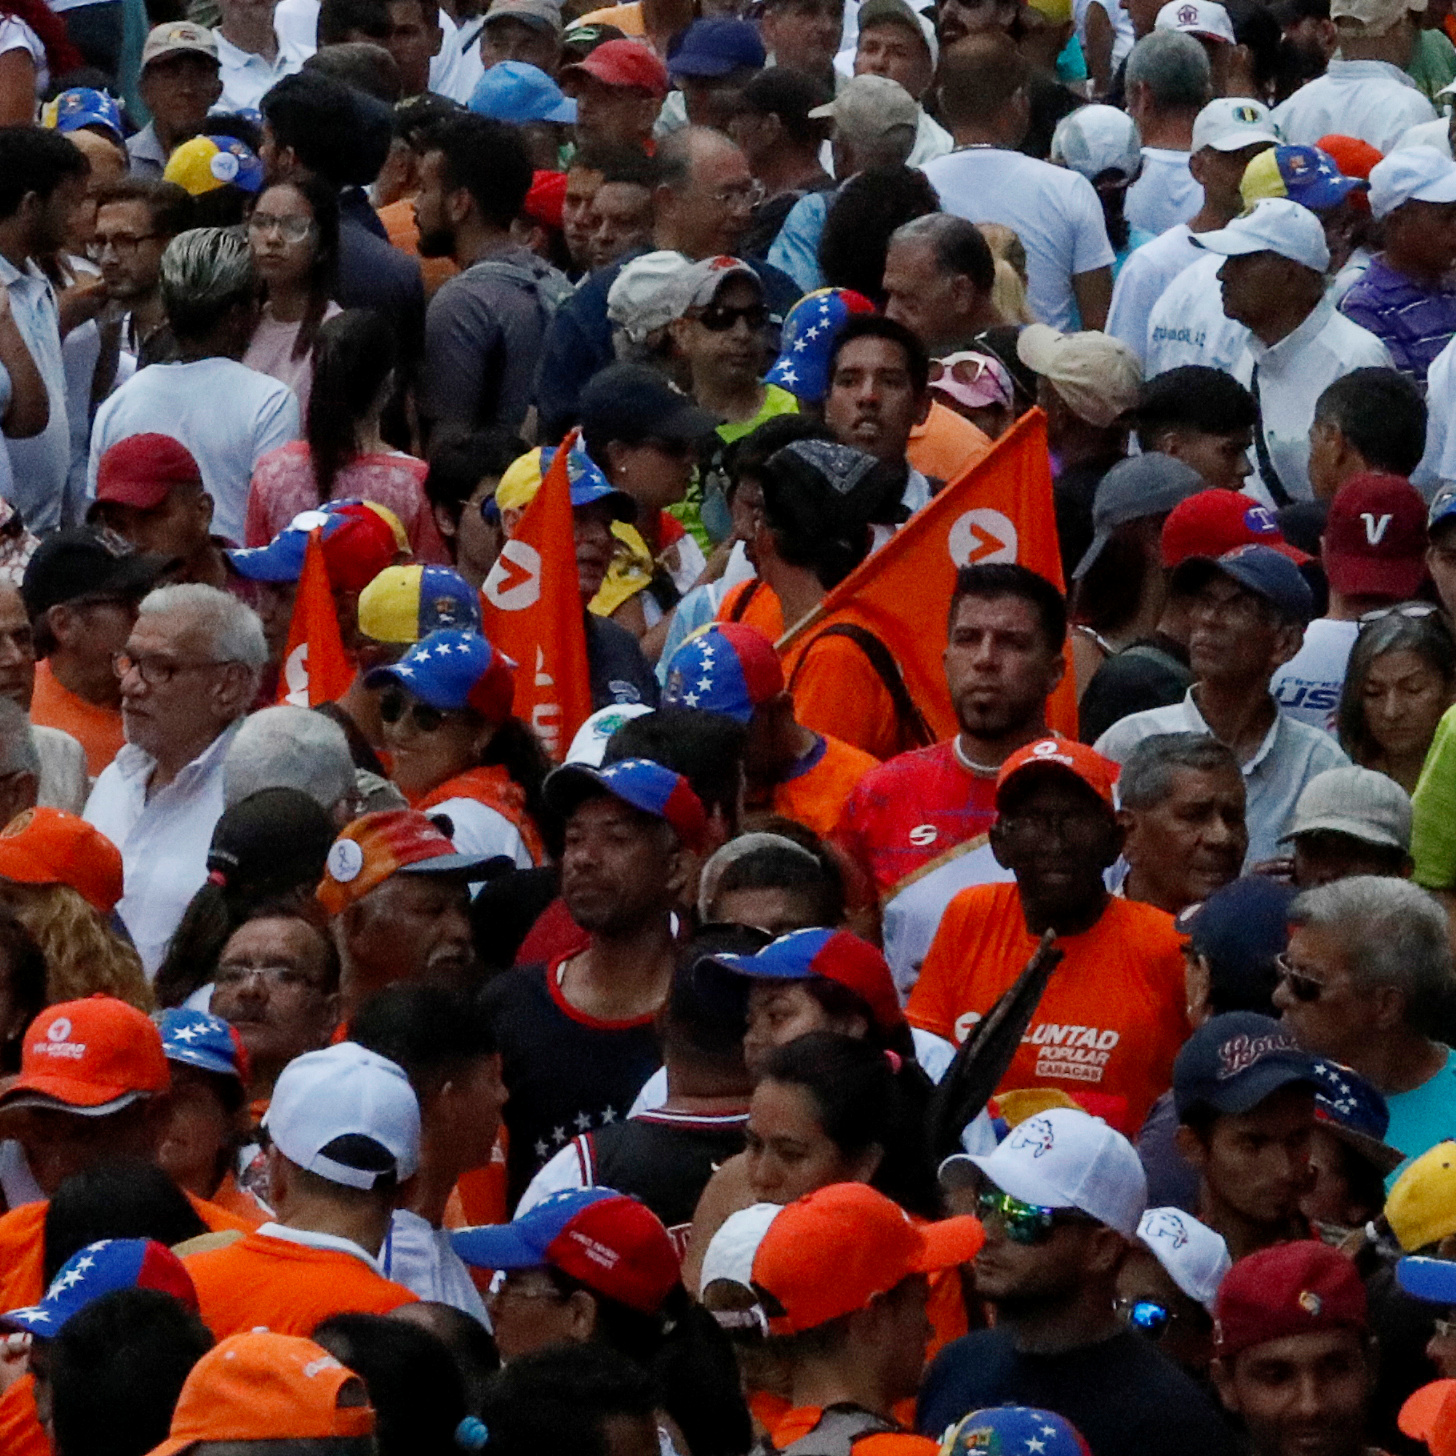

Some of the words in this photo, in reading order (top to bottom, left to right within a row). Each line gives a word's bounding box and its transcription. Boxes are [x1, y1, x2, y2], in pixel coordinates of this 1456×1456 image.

[1248, 506, 1275, 530] T
[1360, 512, 1393, 545] V
[1021, 1021, 1120, 1051] LUNTAD
[1037, 1046, 1111, 1066] POPULAR
[1037, 1062, 1102, 1082] CARACAS
